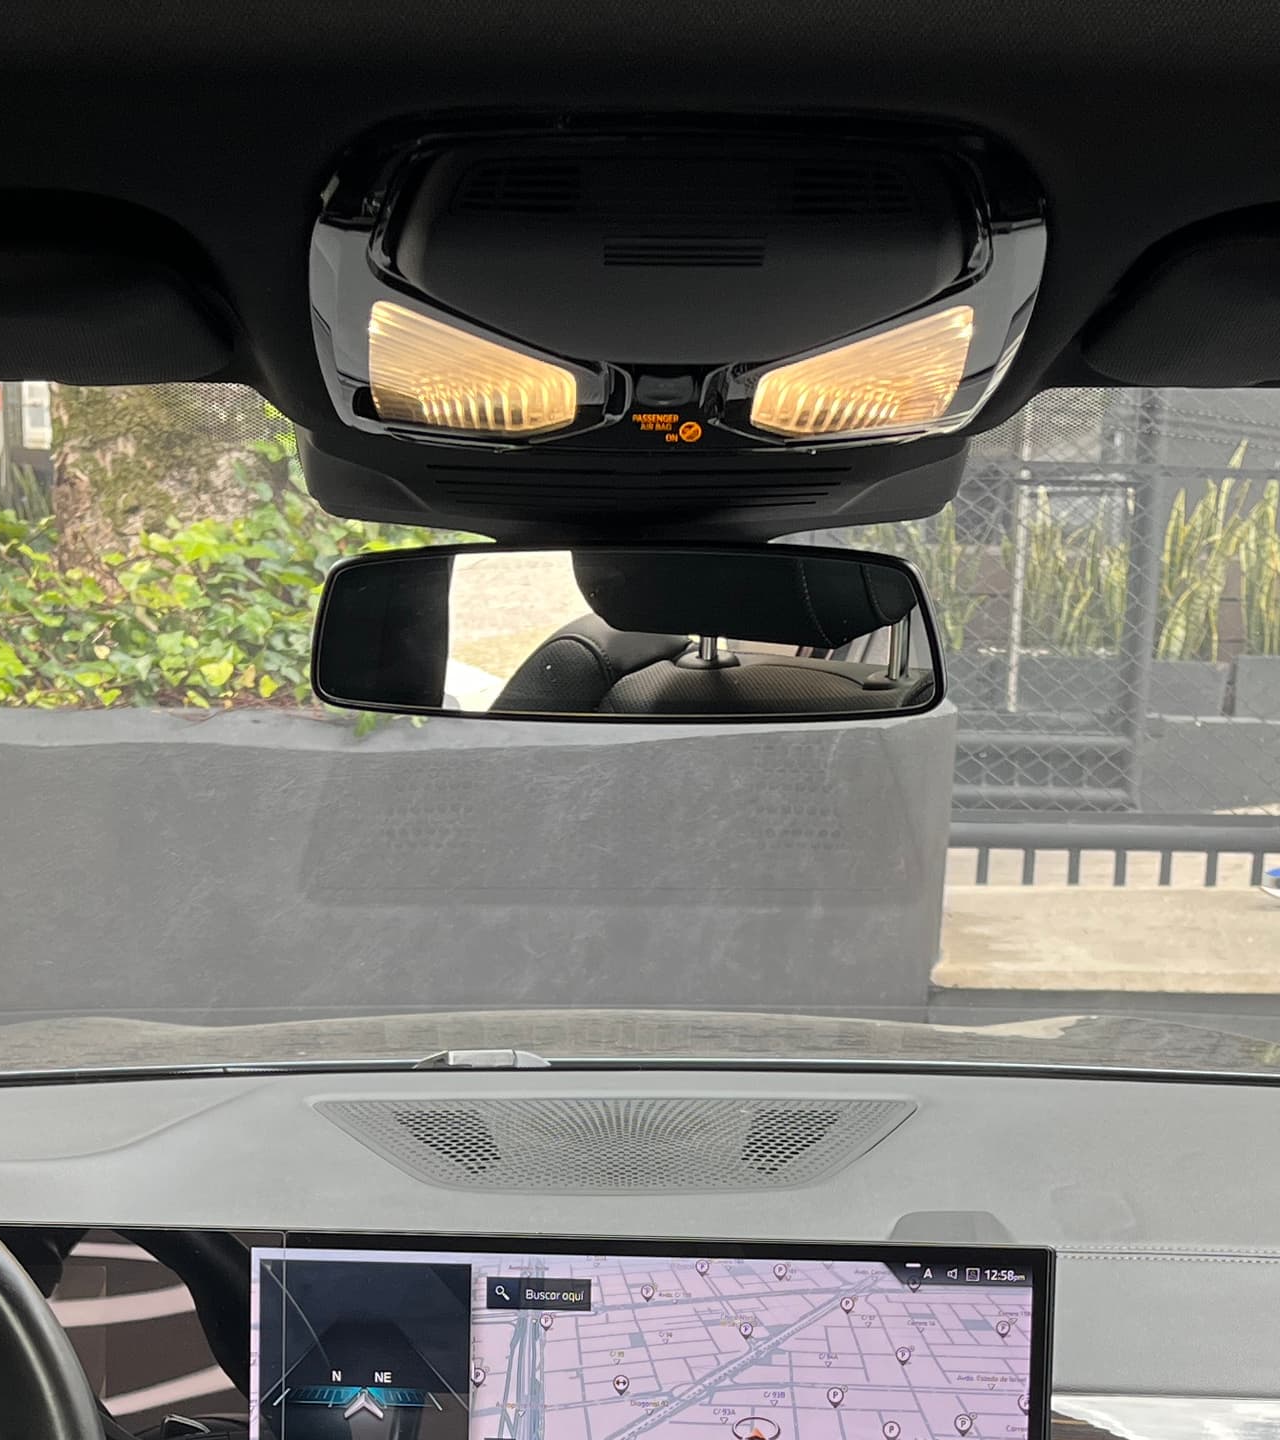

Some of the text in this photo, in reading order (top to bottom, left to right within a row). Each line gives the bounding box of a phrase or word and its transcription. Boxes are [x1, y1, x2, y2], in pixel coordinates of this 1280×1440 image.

[632, 414, 679, 423] PASSENGER
[665, 433, 679, 442] ON
[525, 1288, 561, 1300] Buscar
[332, 1370, 392, 1384] N NE
